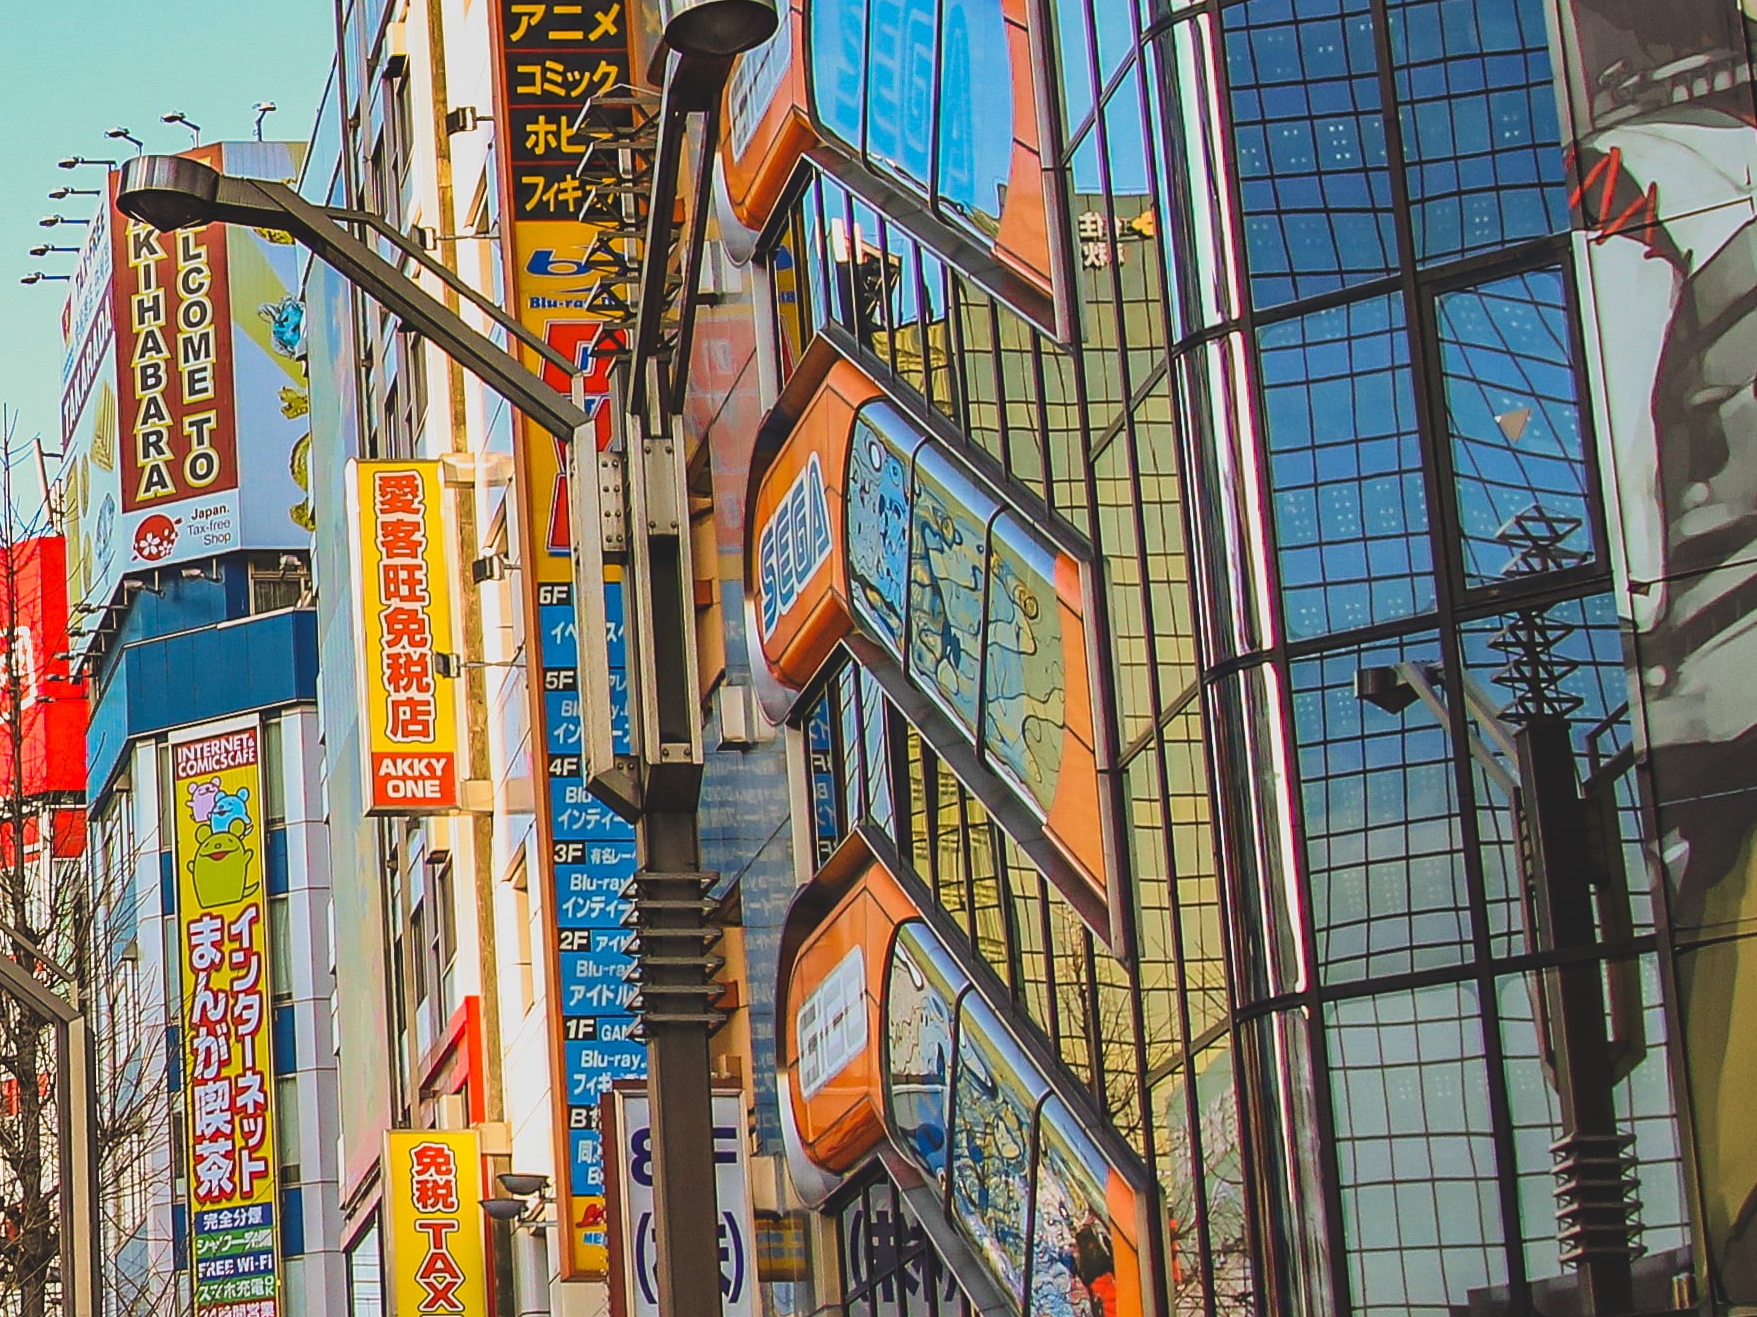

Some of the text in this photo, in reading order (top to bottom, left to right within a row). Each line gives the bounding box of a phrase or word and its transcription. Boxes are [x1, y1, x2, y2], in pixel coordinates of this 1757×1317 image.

[510, 1, 620, 44] アニメ
[515, 60, 620, 97] コミック
[130, 222, 175, 500] KIHABARA
[179, 232, 220, 486] LCOME TO
[191, 505, 230, 522] Japan.
[187, 519, 231, 536] Tax-free
[202, 532, 231, 548] Shop
[760, 450, 833, 643] SEGA
[540, 586, 568, 604] 6F
[376, 471, 435, 744] 愛客旺免税店
[545, 671, 574, 690] 5F
[378, 758, 448, 777] AKKY
[550, 758, 578, 776] 4F
[386, 779, 441, 799] ONE
[554, 844, 583, 864] 3F
[559, 932, 588, 951] 2F
[566, 1020, 595, 1040] 1F
[188, 914, 233, 1202] まんが喫茶
[228, 904, 270, 1199] インターネット
[410, 1143, 458, 1211] 免税
[198, 1255, 273, 1279] FREE Wi-Fi
[415, 1220, 464, 1313] TAX
